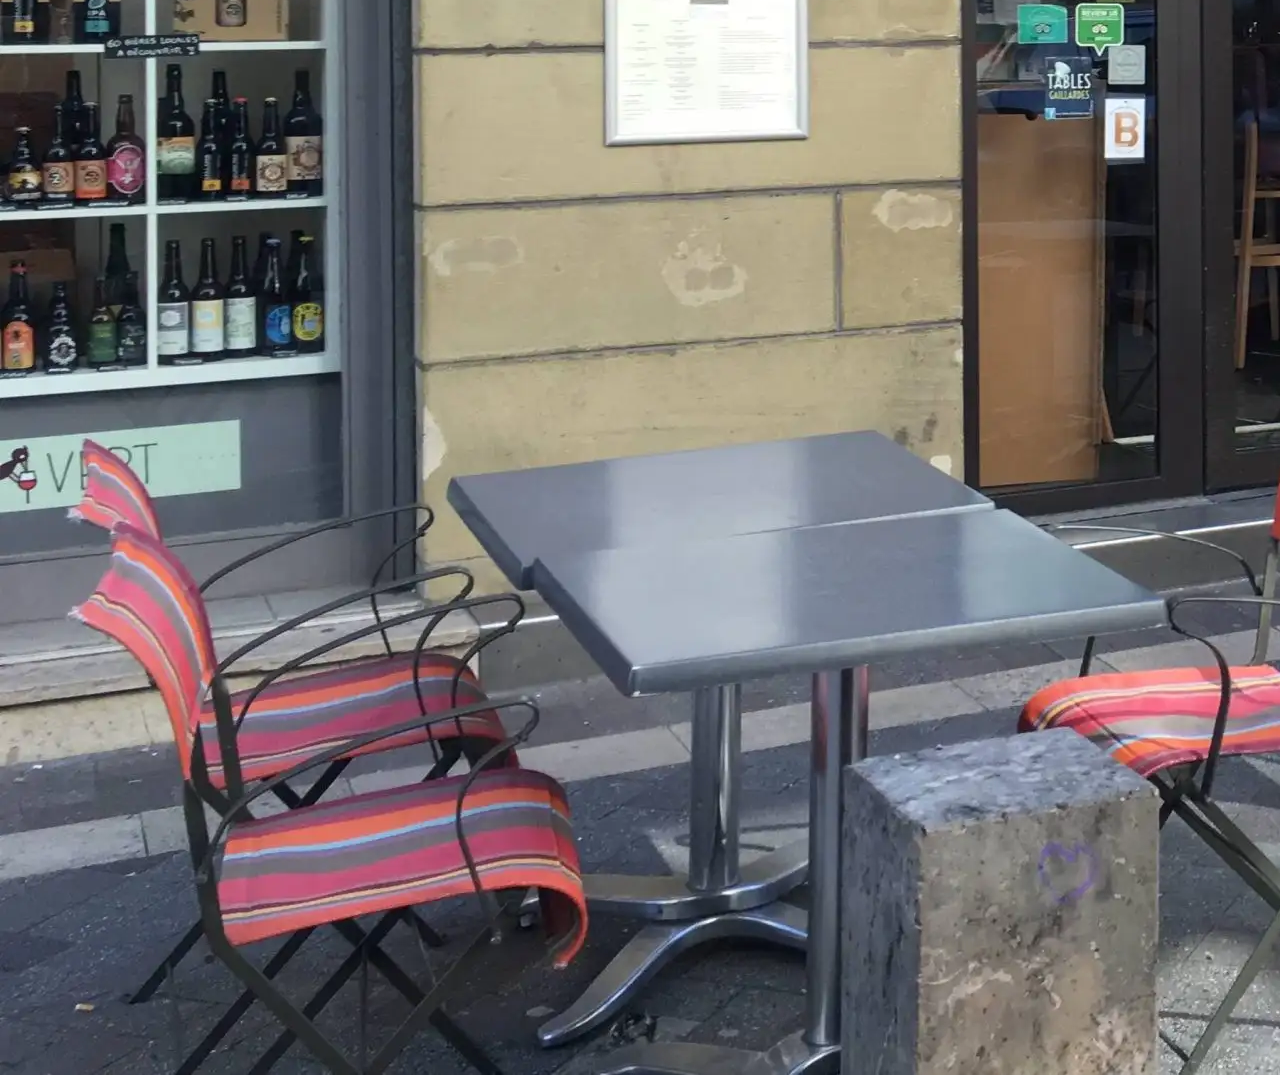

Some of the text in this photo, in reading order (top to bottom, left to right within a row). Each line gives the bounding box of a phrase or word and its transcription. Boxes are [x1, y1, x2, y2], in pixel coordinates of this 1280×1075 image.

[1048, 74, 1091, 89] TABLES
[1049, 90, 1090, 100] GAILLARDES
[1114, 112, 1139, 147] B
